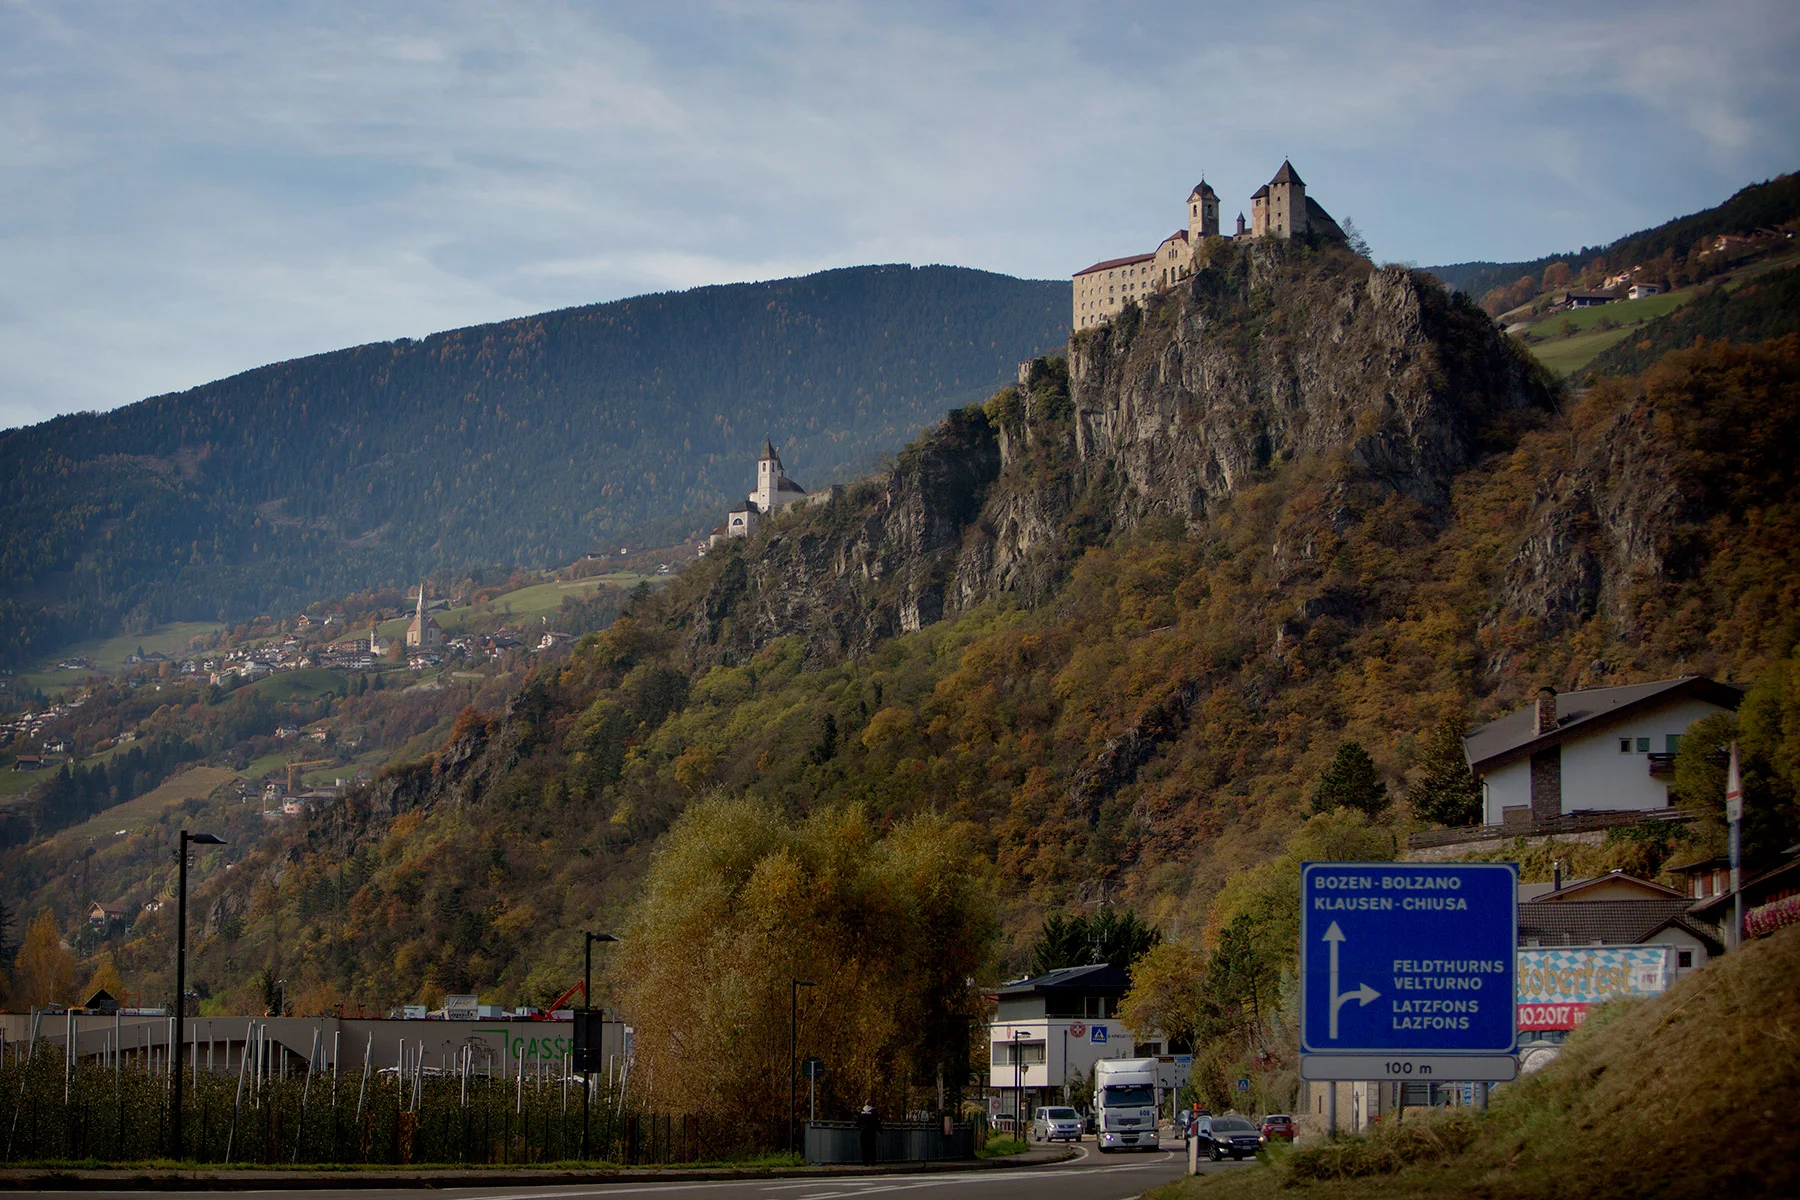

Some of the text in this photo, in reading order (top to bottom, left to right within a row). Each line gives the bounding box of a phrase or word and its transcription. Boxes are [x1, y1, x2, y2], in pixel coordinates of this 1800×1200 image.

[1393, 960, 1505, 973] FELDTHURNS
[1518, 954, 1632, 996] toberfest
[1394, 977, 1483, 990] VELTURNO
[1393, 1000, 1479, 1013] LATZFONS
[1518, 1007, 1570, 1025] 10.2017
[1393, 1016, 1470, 1030] LAZFONS
[1385, 1062, 1432, 1074] 100 m
